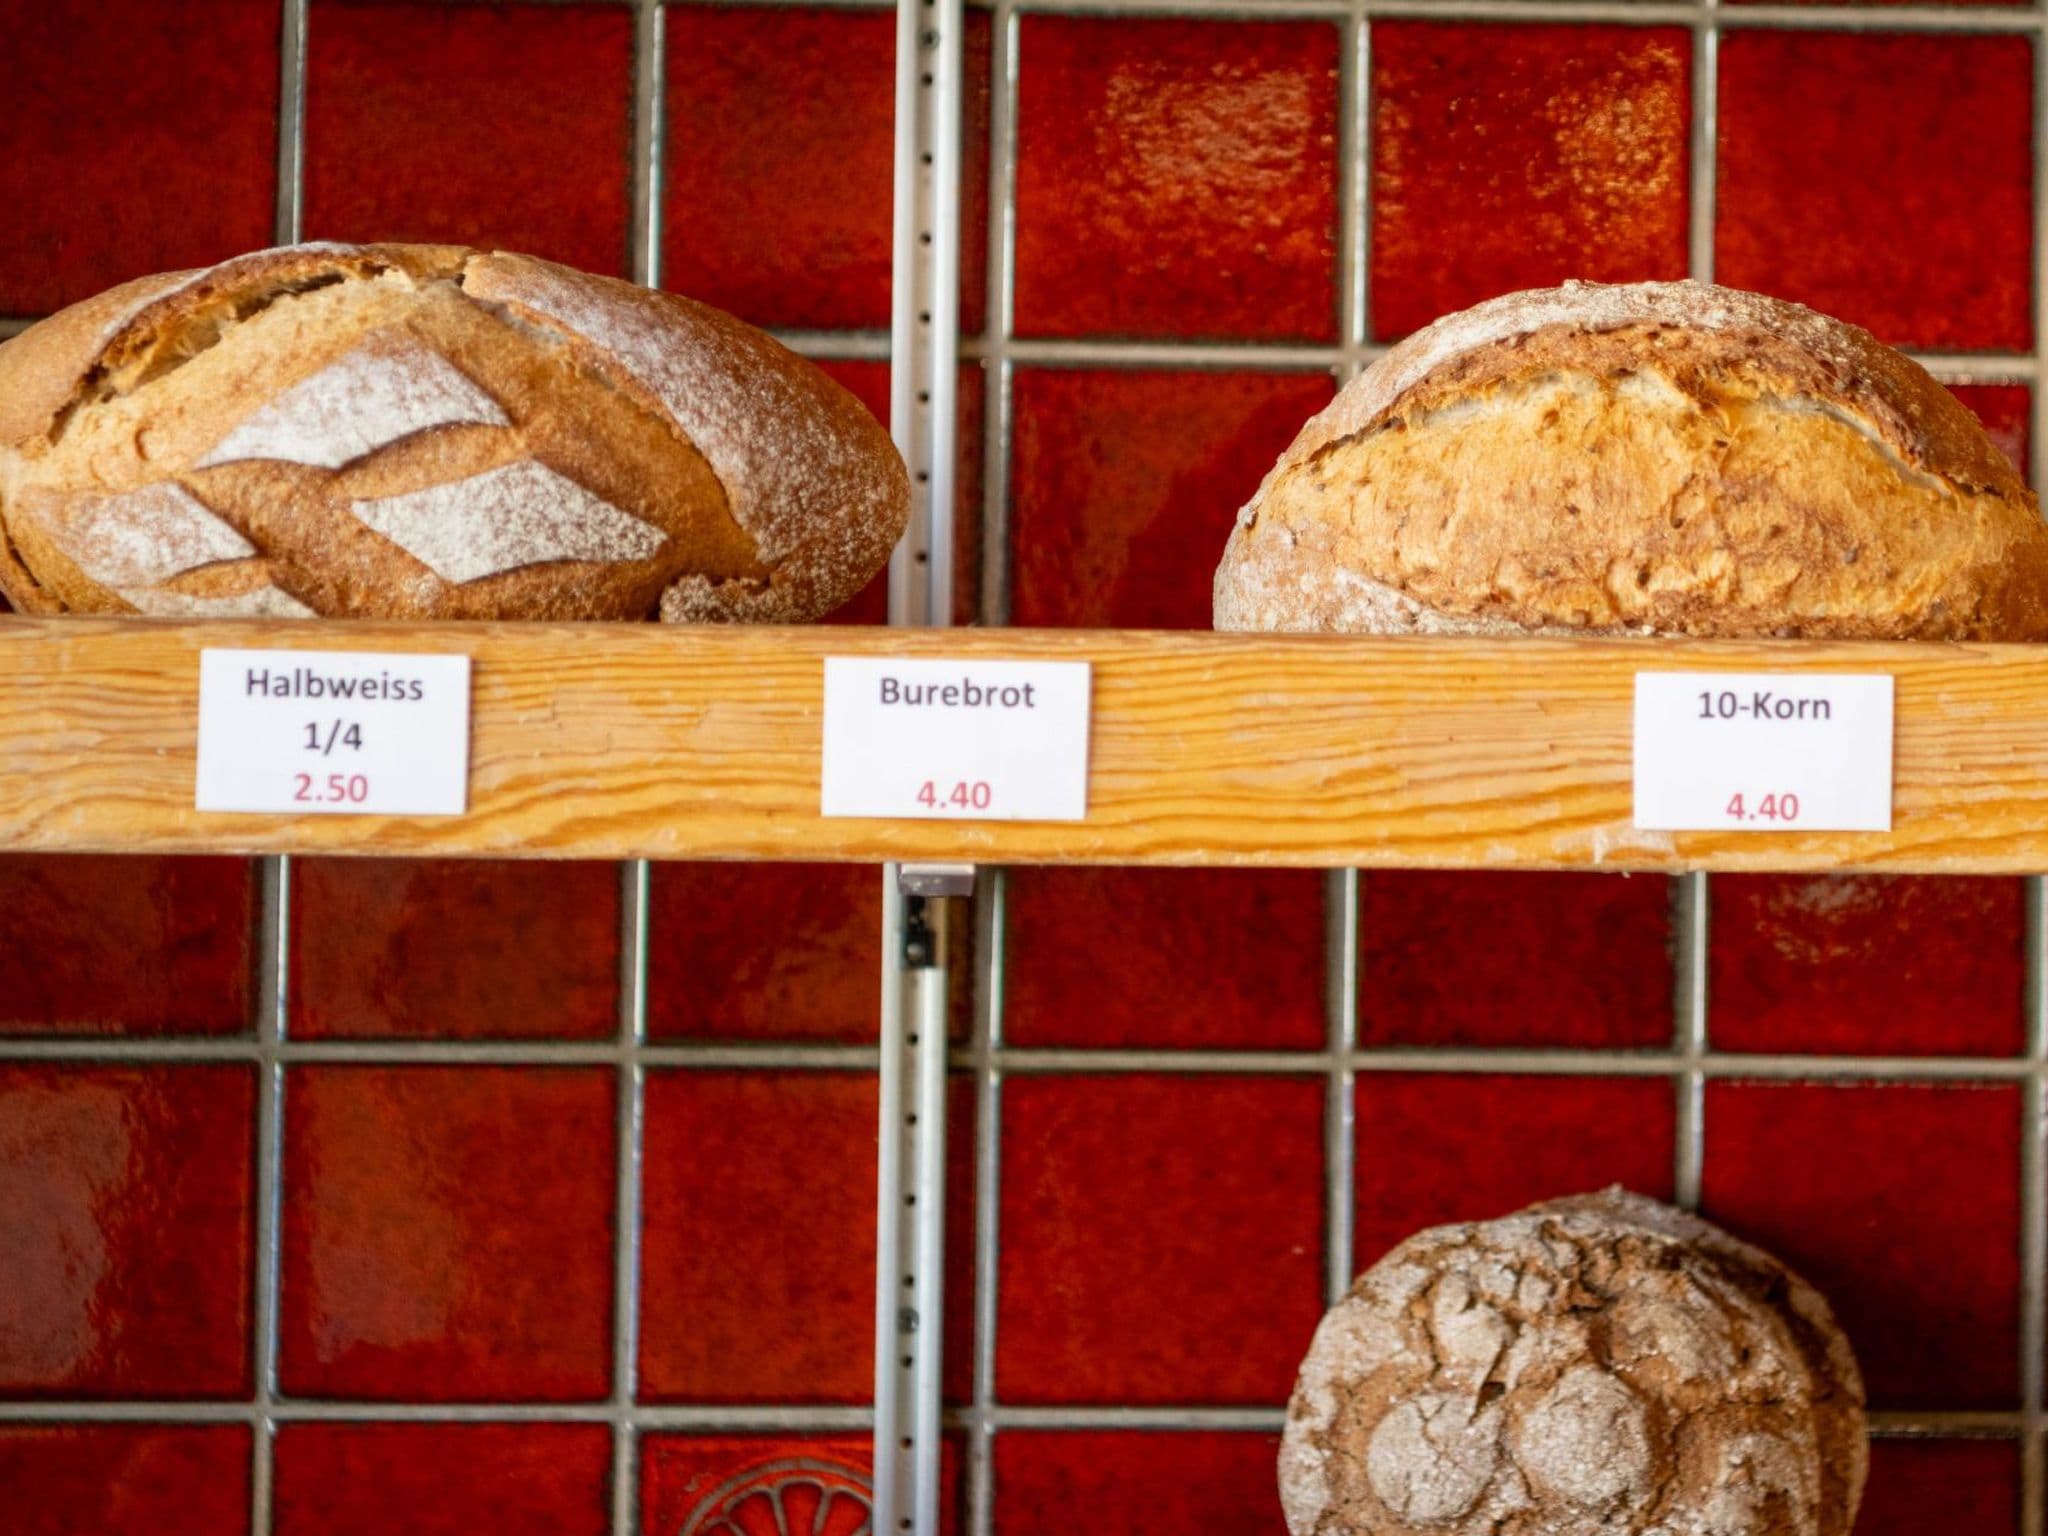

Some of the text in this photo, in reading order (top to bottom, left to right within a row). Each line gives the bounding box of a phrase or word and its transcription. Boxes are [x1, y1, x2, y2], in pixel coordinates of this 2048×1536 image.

[246, 668, 424, 701] Halbweiss
[880, 677, 1035, 708] Burebrot
[1698, 691, 1831, 720] 10-Korn
[304, 719, 363, 755] 1/4
[294, 773, 368, 803] 2.50
[917, 781, 992, 809] 4.40
[1726, 793, 1799, 821] 4.40
